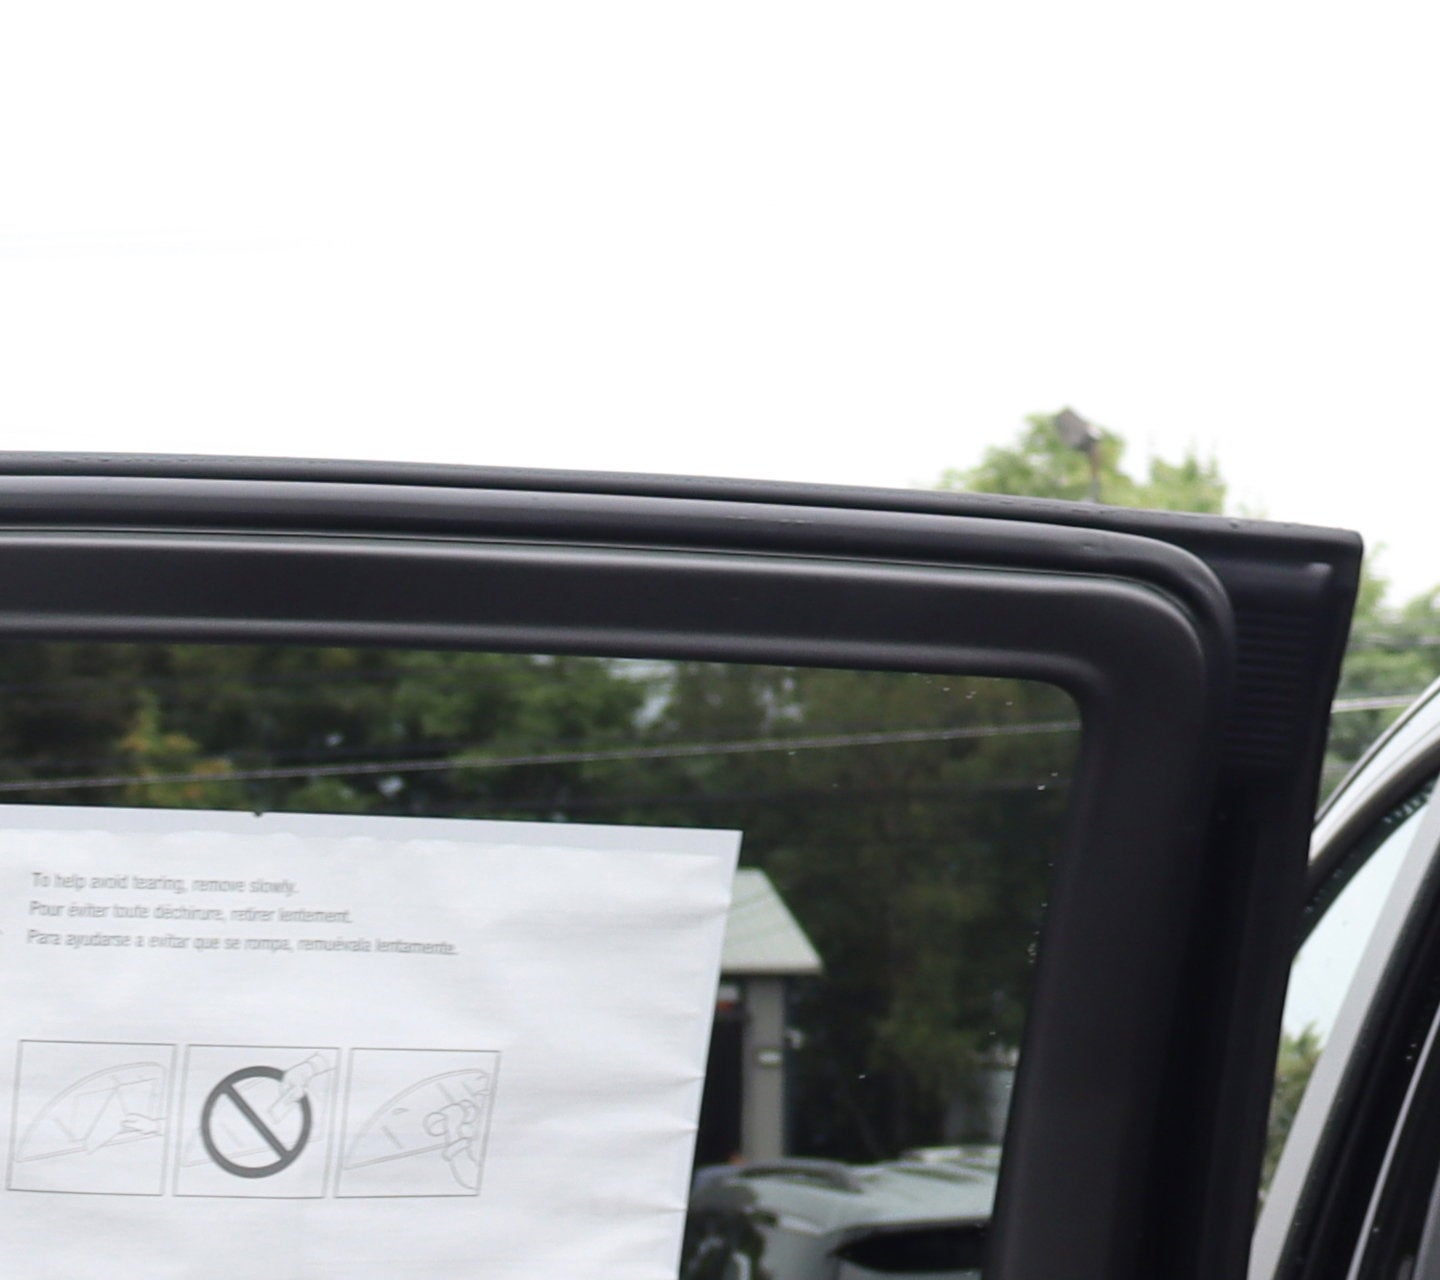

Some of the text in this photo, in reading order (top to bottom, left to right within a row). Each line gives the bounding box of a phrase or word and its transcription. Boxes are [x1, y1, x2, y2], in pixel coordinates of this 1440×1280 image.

[32, 872, 299, 897] To help avoid tearing, remove slowly.
[29, 900, 64, 916] Pour
[68, 902, 110, 918] éviter
[113, 903, 149, 918] toute
[230, 908, 275, 922] retirer
[27, 929, 60, 946] Para
[137, 935, 144, 947] a
[149, 933, 188, 948] evitar
[193, 936, 220, 952] que
[224, 937, 240, 949] se
